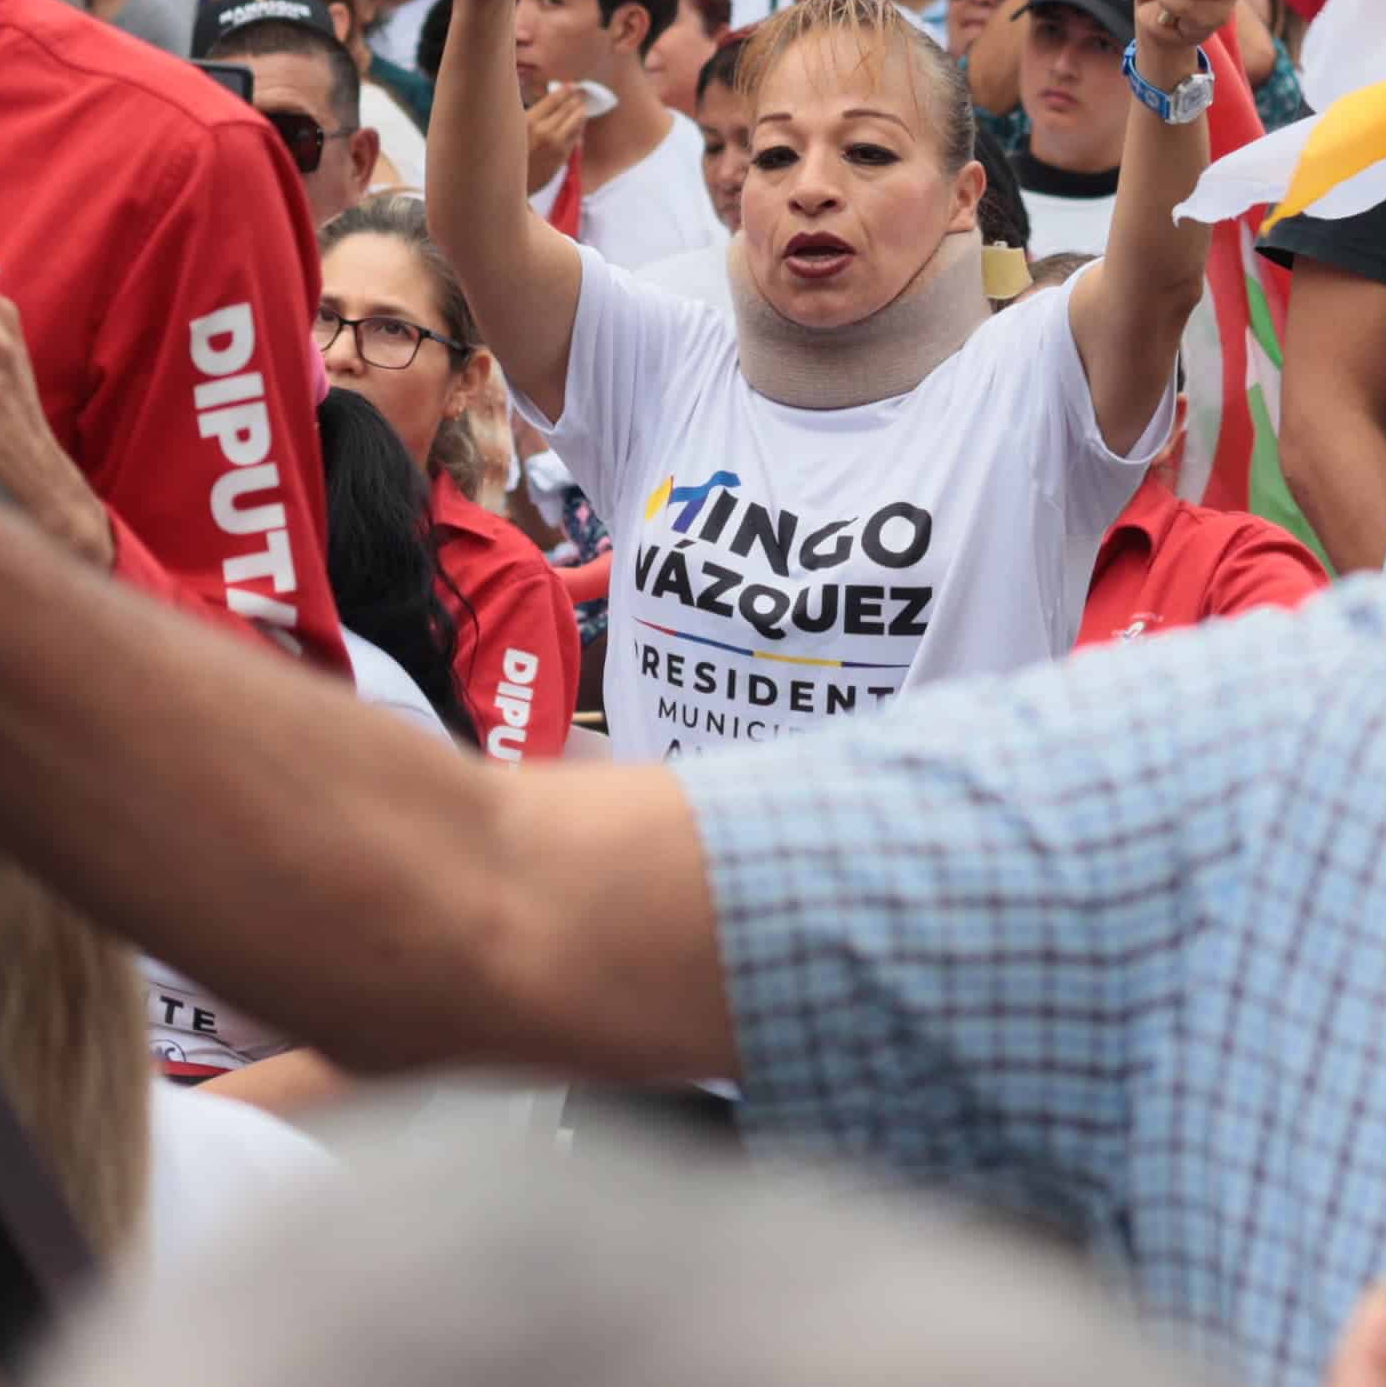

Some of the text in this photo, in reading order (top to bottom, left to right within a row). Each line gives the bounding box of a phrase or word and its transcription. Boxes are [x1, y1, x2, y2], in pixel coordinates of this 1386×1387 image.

[644, 470, 932, 578] MINGO
[634, 538, 933, 640] VÁZQUEZ
[633, 636, 896, 716] RESIDENT
